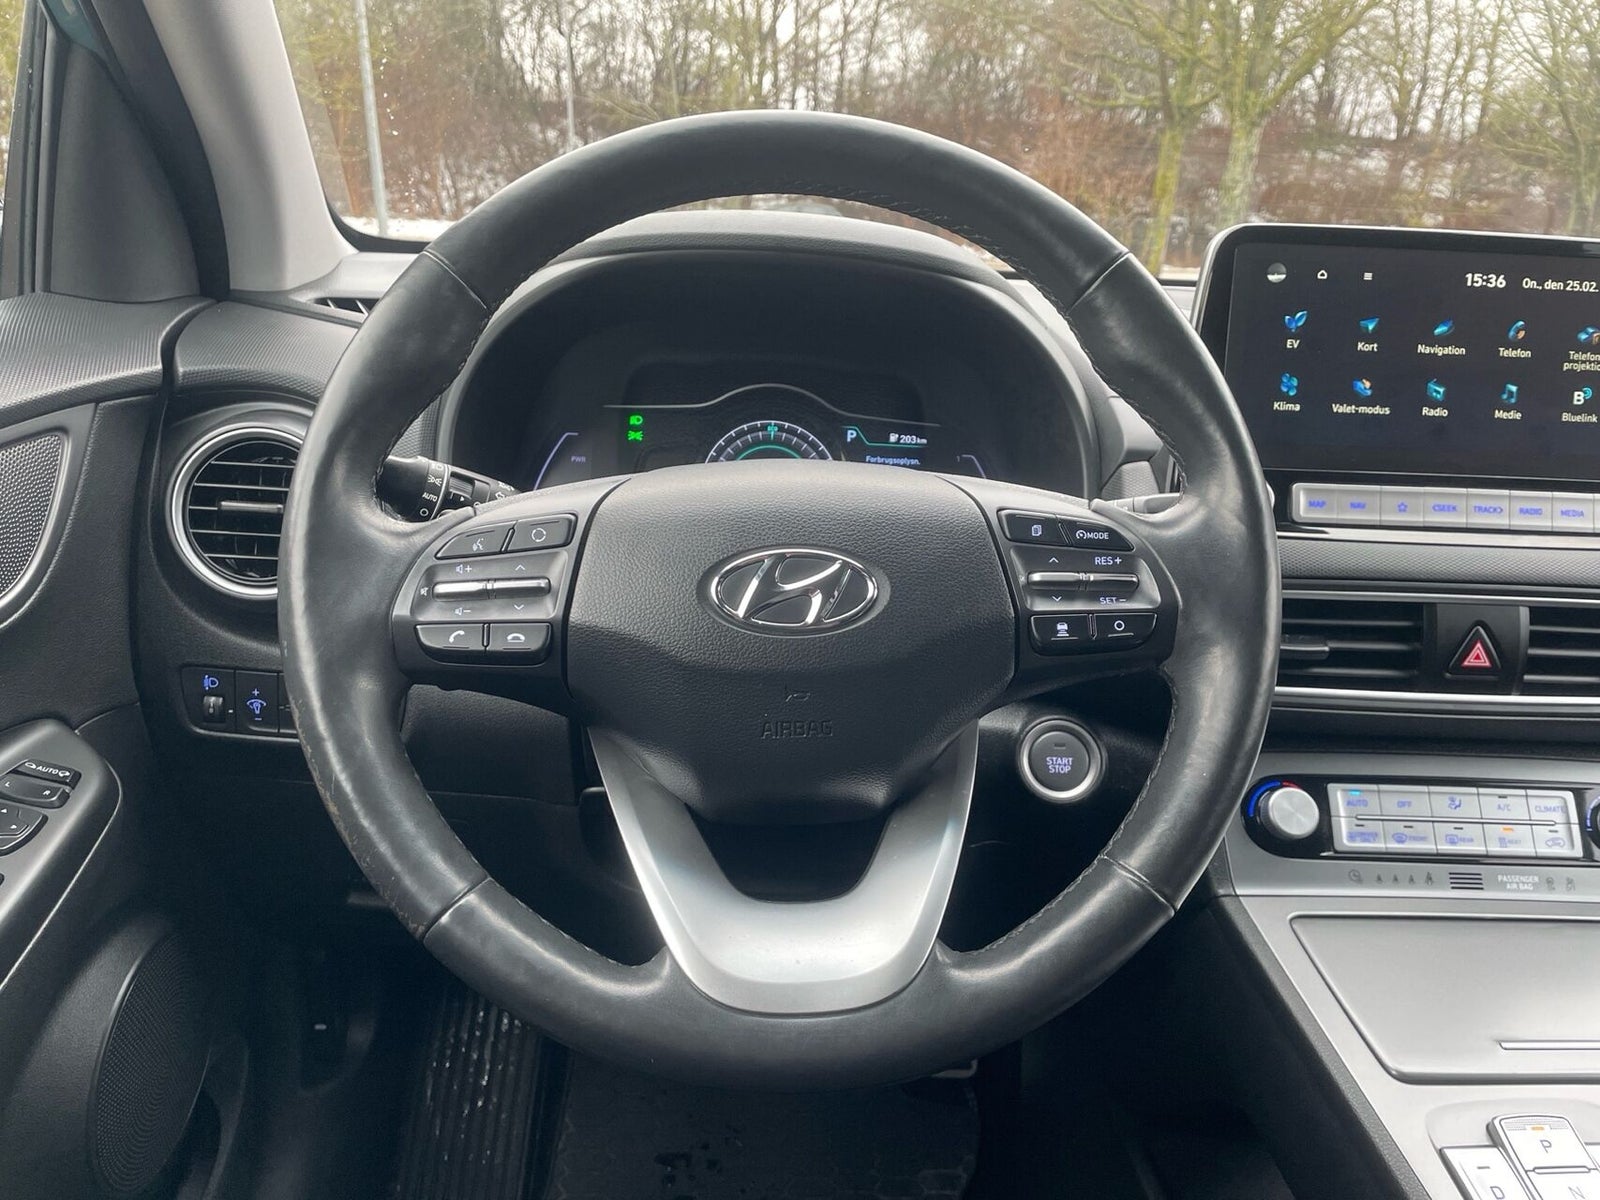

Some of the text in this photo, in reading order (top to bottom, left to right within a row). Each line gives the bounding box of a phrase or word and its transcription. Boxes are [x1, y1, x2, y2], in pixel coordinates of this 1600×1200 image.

[1465, 273, 1506, 288] 15:36
[1544, 279, 1564, 290] den
[1566, 280, 1599, 292] 25.02.
[1286, 339, 1300, 349] EV
[1357, 342, 1378, 352] Kort
[1417, 344, 1466, 356] Navigation
[1498, 347, 1532, 358] Telefon
[1273, 401, 1301, 412] Klima
[1332, 403, 1391, 415] Valet-modus
[1422, 406, 1449, 417] Radio
[1494, 409, 1522, 420] Medie
[1561, 412, 1598, 423] Bluelink
[846, 430, 857, 442] P
[422, 492, 438, 502] AUTO
[1519, 507, 1543, 516] RADIO
[1561, 509, 1585, 518] MEDIA
[1087, 531, 1110, 540] MODE
[761, 720, 833, 739] AIRBAG
[1046, 756, 1073, 766] START
[36, 766, 59, 775] AUTO
[1048, 764, 1072, 774] STOP
[1497, 874, 1539, 884] PASSENGER
[1540, 1139, 1552, 1153] P
[1490, 1185, 1505, 1200] D
[1568, 1186, 1585, 1200] N
